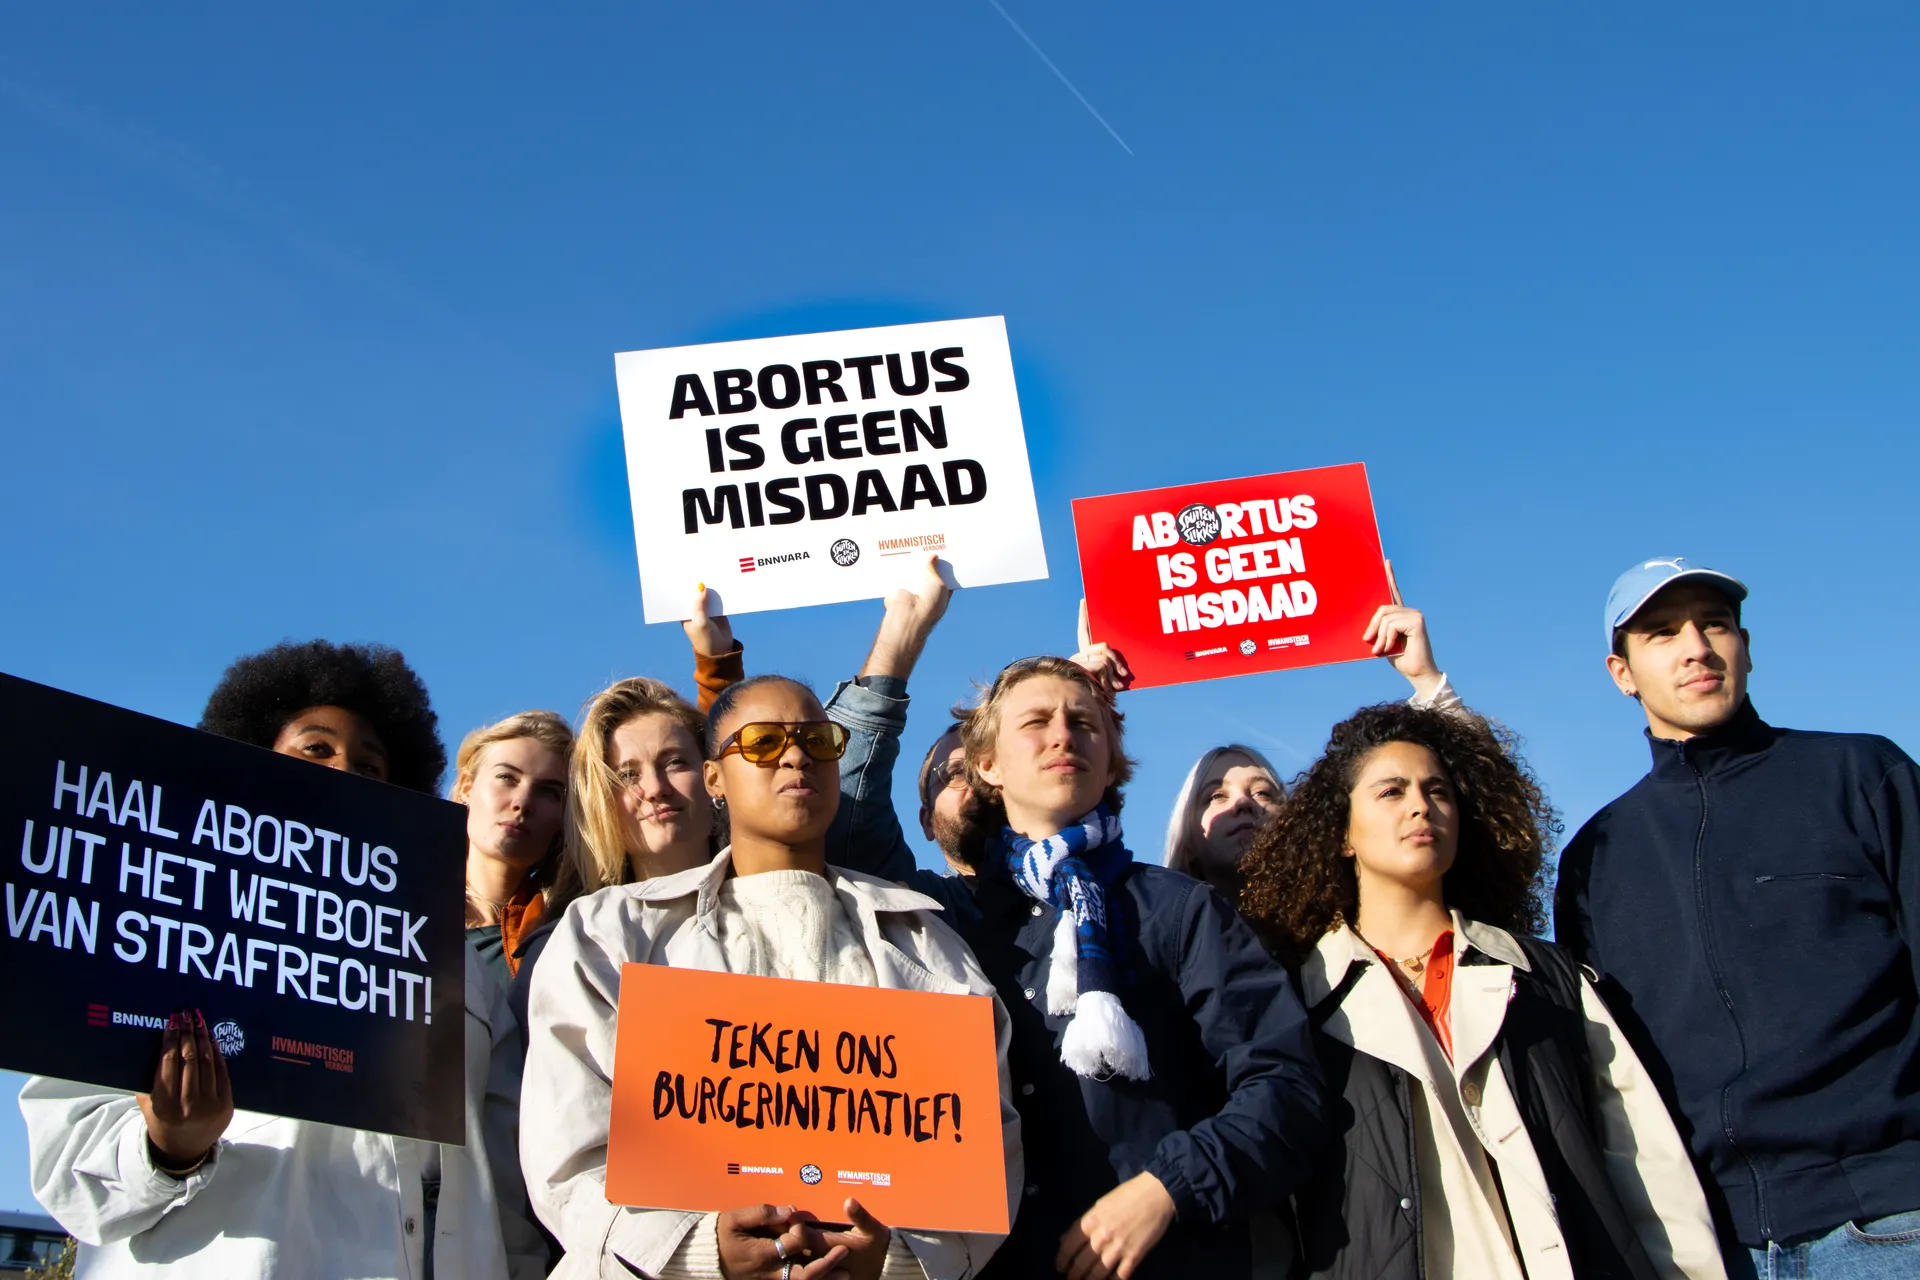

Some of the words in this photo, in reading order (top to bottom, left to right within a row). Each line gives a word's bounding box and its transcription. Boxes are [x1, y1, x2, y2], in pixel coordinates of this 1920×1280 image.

[669, 347, 970, 420] ABORTUS
[705, 424, 765, 473] IS
[781, 405, 948, 465] GEEN
[682, 459, 987, 534] MISDAAD
[1178, 506, 1215, 532] SPUITEN
[1196, 520, 1206, 528] EN
[1183, 519, 1219, 542] SLIKKEN
[758, 551, 810, 567] BNNVARA
[1157, 552, 1198, 591] IS
[1205, 537, 1306, 584] GEEN
[1158, 579, 1317, 634] MISDAAD
[53, 760, 179, 839] HAAL
[192, 799, 398, 892] ABORTUS
[21, 819, 106, 884] UIT
[119, 842, 216, 911] HET
[229, 869, 429, 962] WETBOEK
[6, 883, 100, 954] VAN
[113, 911, 432, 1024] STRAFRECHT!
[112, 1011, 169, 1030] BNNVA
[213, 1021, 244, 1040] SPUITEN
[705, 1018, 819, 1073] TEKEN
[836, 1031, 897, 1079] ONS
[653, 1070, 963, 1143] BURGERINITIATIEF!
[741, 1166, 784, 1174] BNNVARA
